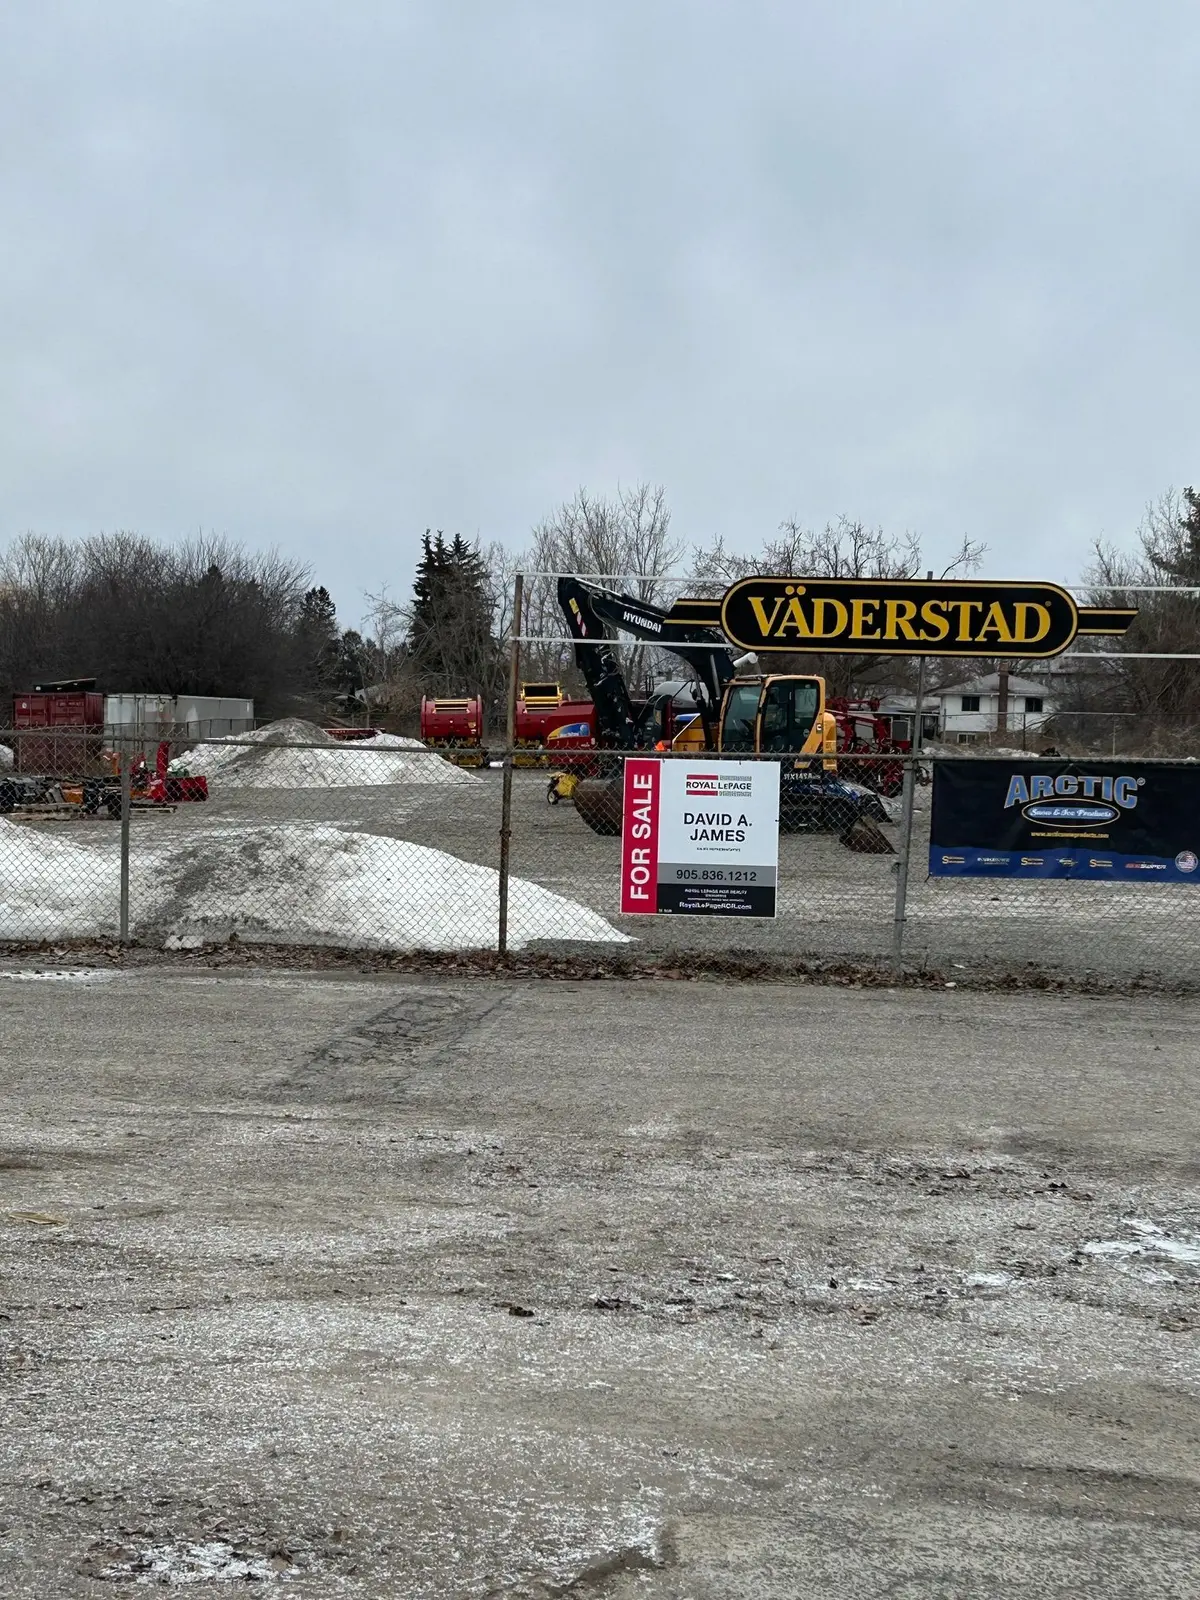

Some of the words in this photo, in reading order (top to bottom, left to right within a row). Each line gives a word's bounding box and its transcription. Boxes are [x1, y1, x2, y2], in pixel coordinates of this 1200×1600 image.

[623, 611, 662, 633] HYUNDAI
[747, 585, 1051, 643] VÄDERSTAD
[686, 781, 717, 789] ROYAL
[1003, 775, 1138, 809] ARCTIC
[631, 774, 653, 840] SALE
[1029, 808, 1052, 816] Snow
[1075, 809, 1112, 818] Products
[684, 812, 732, 826] DAVID
[737, 814, 753, 827] A.
[689, 829, 746, 842] JAMES
[630, 848, 651, 900] FOR
[676, 869, 757, 882] 905.836.1212
